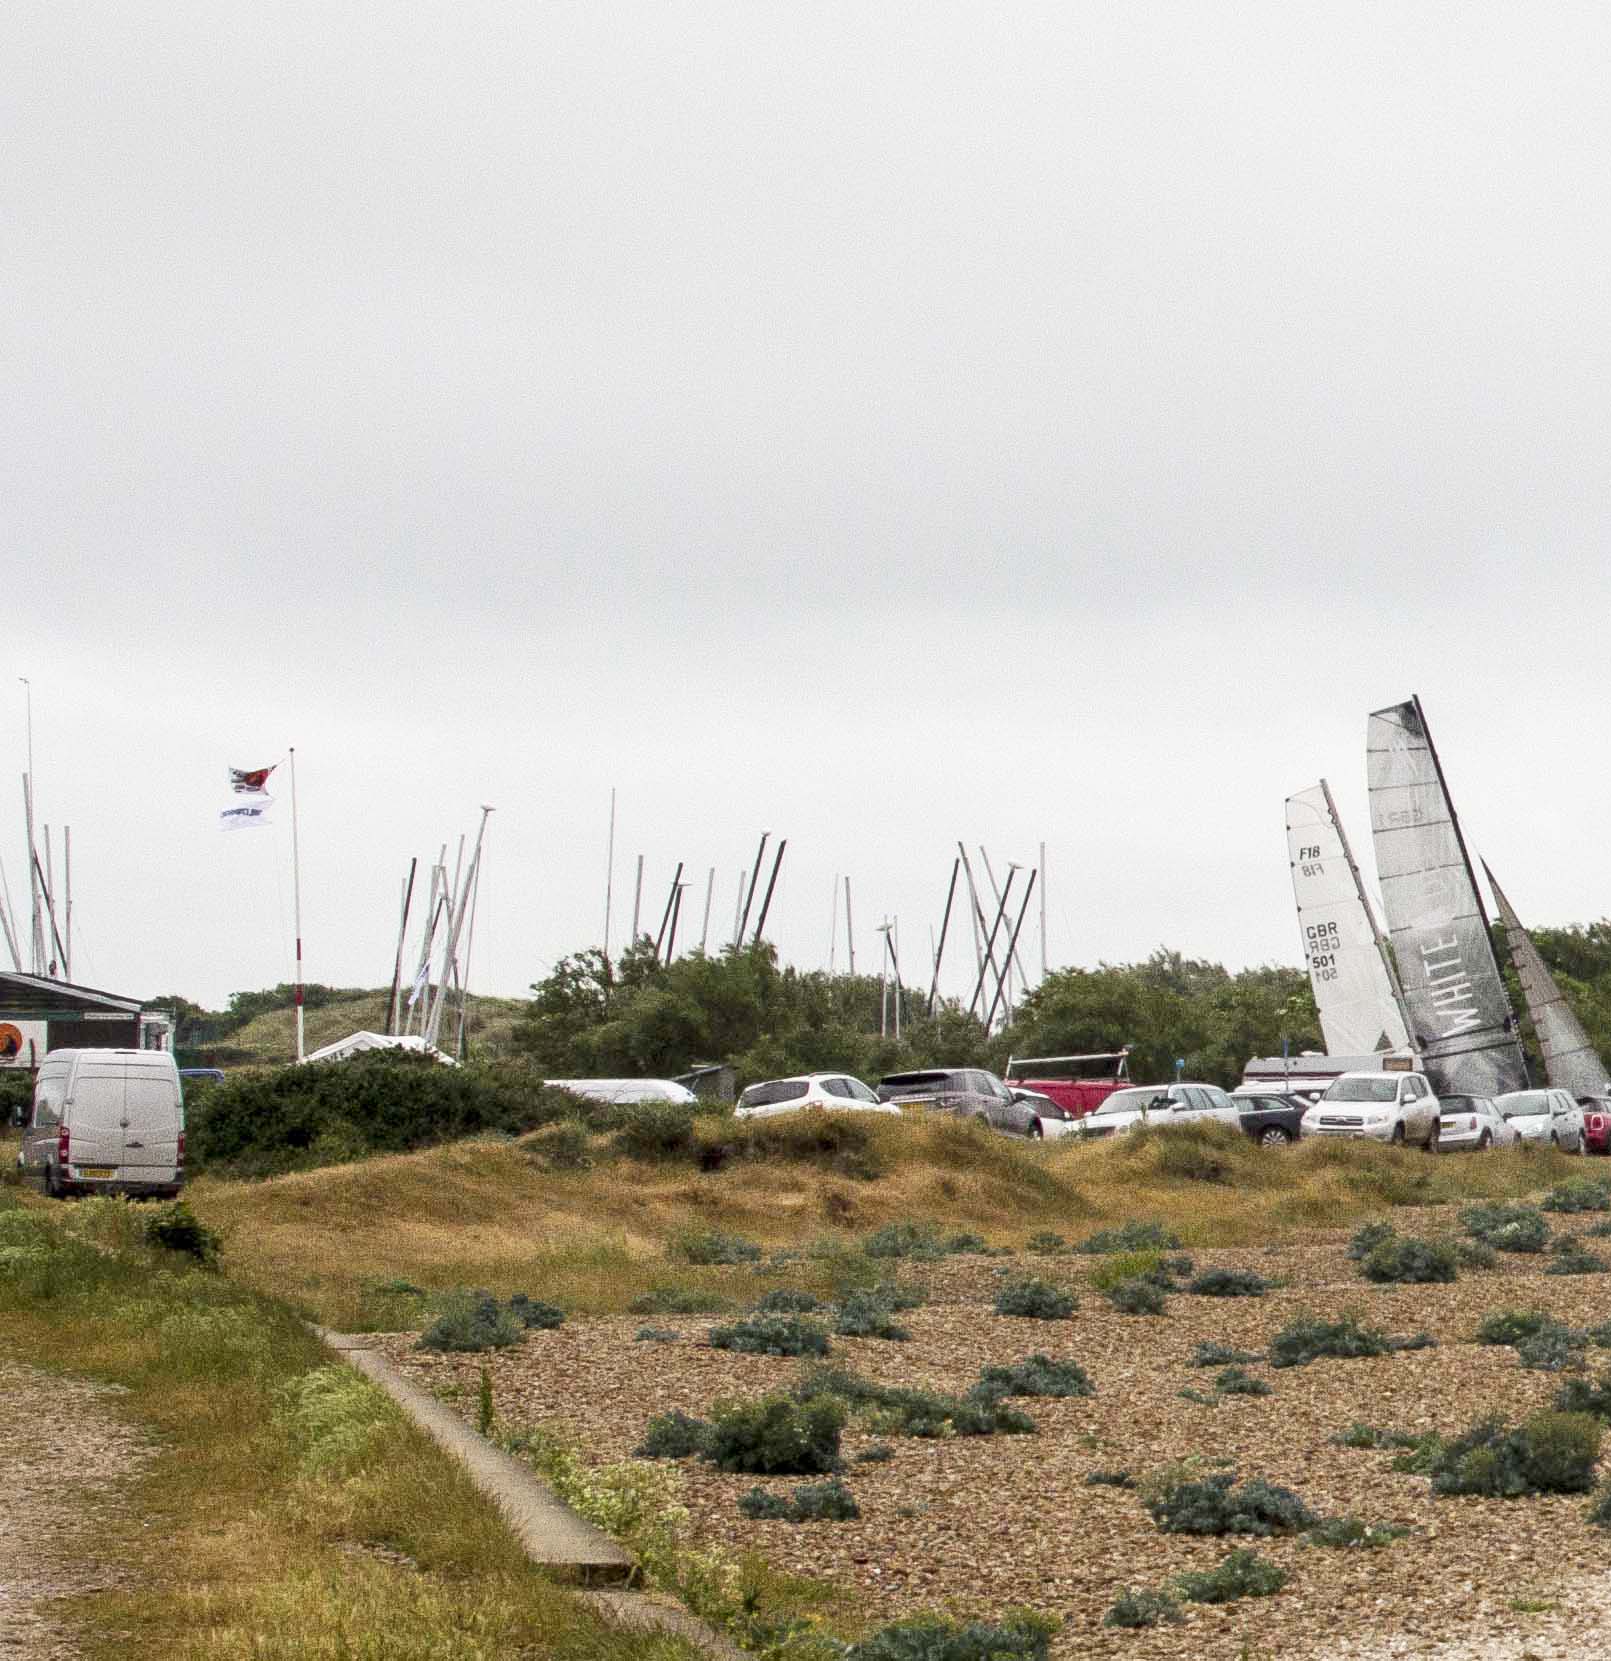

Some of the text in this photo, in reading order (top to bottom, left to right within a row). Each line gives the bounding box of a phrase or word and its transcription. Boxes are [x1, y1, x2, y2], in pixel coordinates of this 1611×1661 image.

[1299, 845, 1321, 860] F18
[1306, 922, 1338, 939] GBR
[1312, 953, 1336, 969] 501
[1421, 934, 1482, 1037] WHITE
